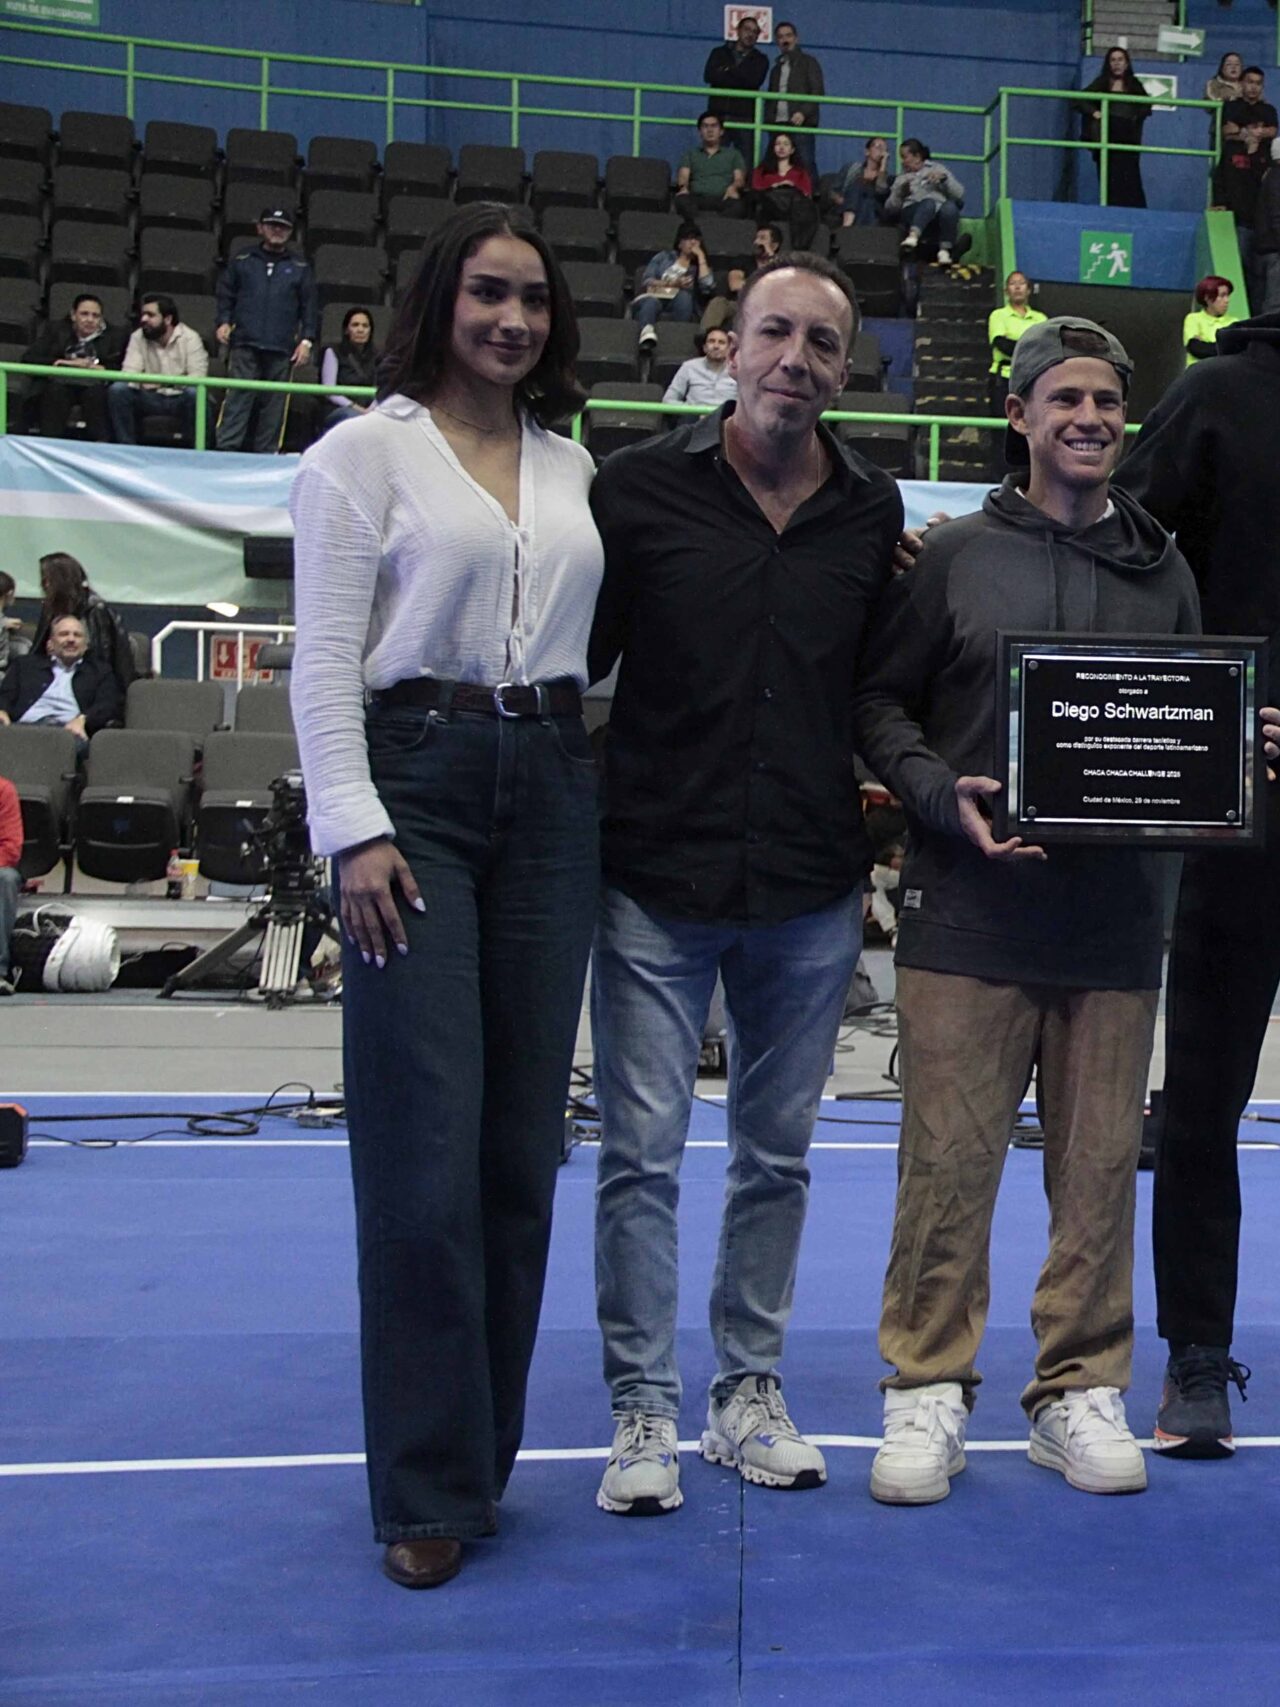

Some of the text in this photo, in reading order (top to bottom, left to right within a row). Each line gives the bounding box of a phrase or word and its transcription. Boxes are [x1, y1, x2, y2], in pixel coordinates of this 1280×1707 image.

[1076, 672, 1132, 681] RECONOCIMIENTO
[1147, 674, 1190, 682] TRAYECTORIA
[1052, 701, 1214, 721] Diego Schwartzman
